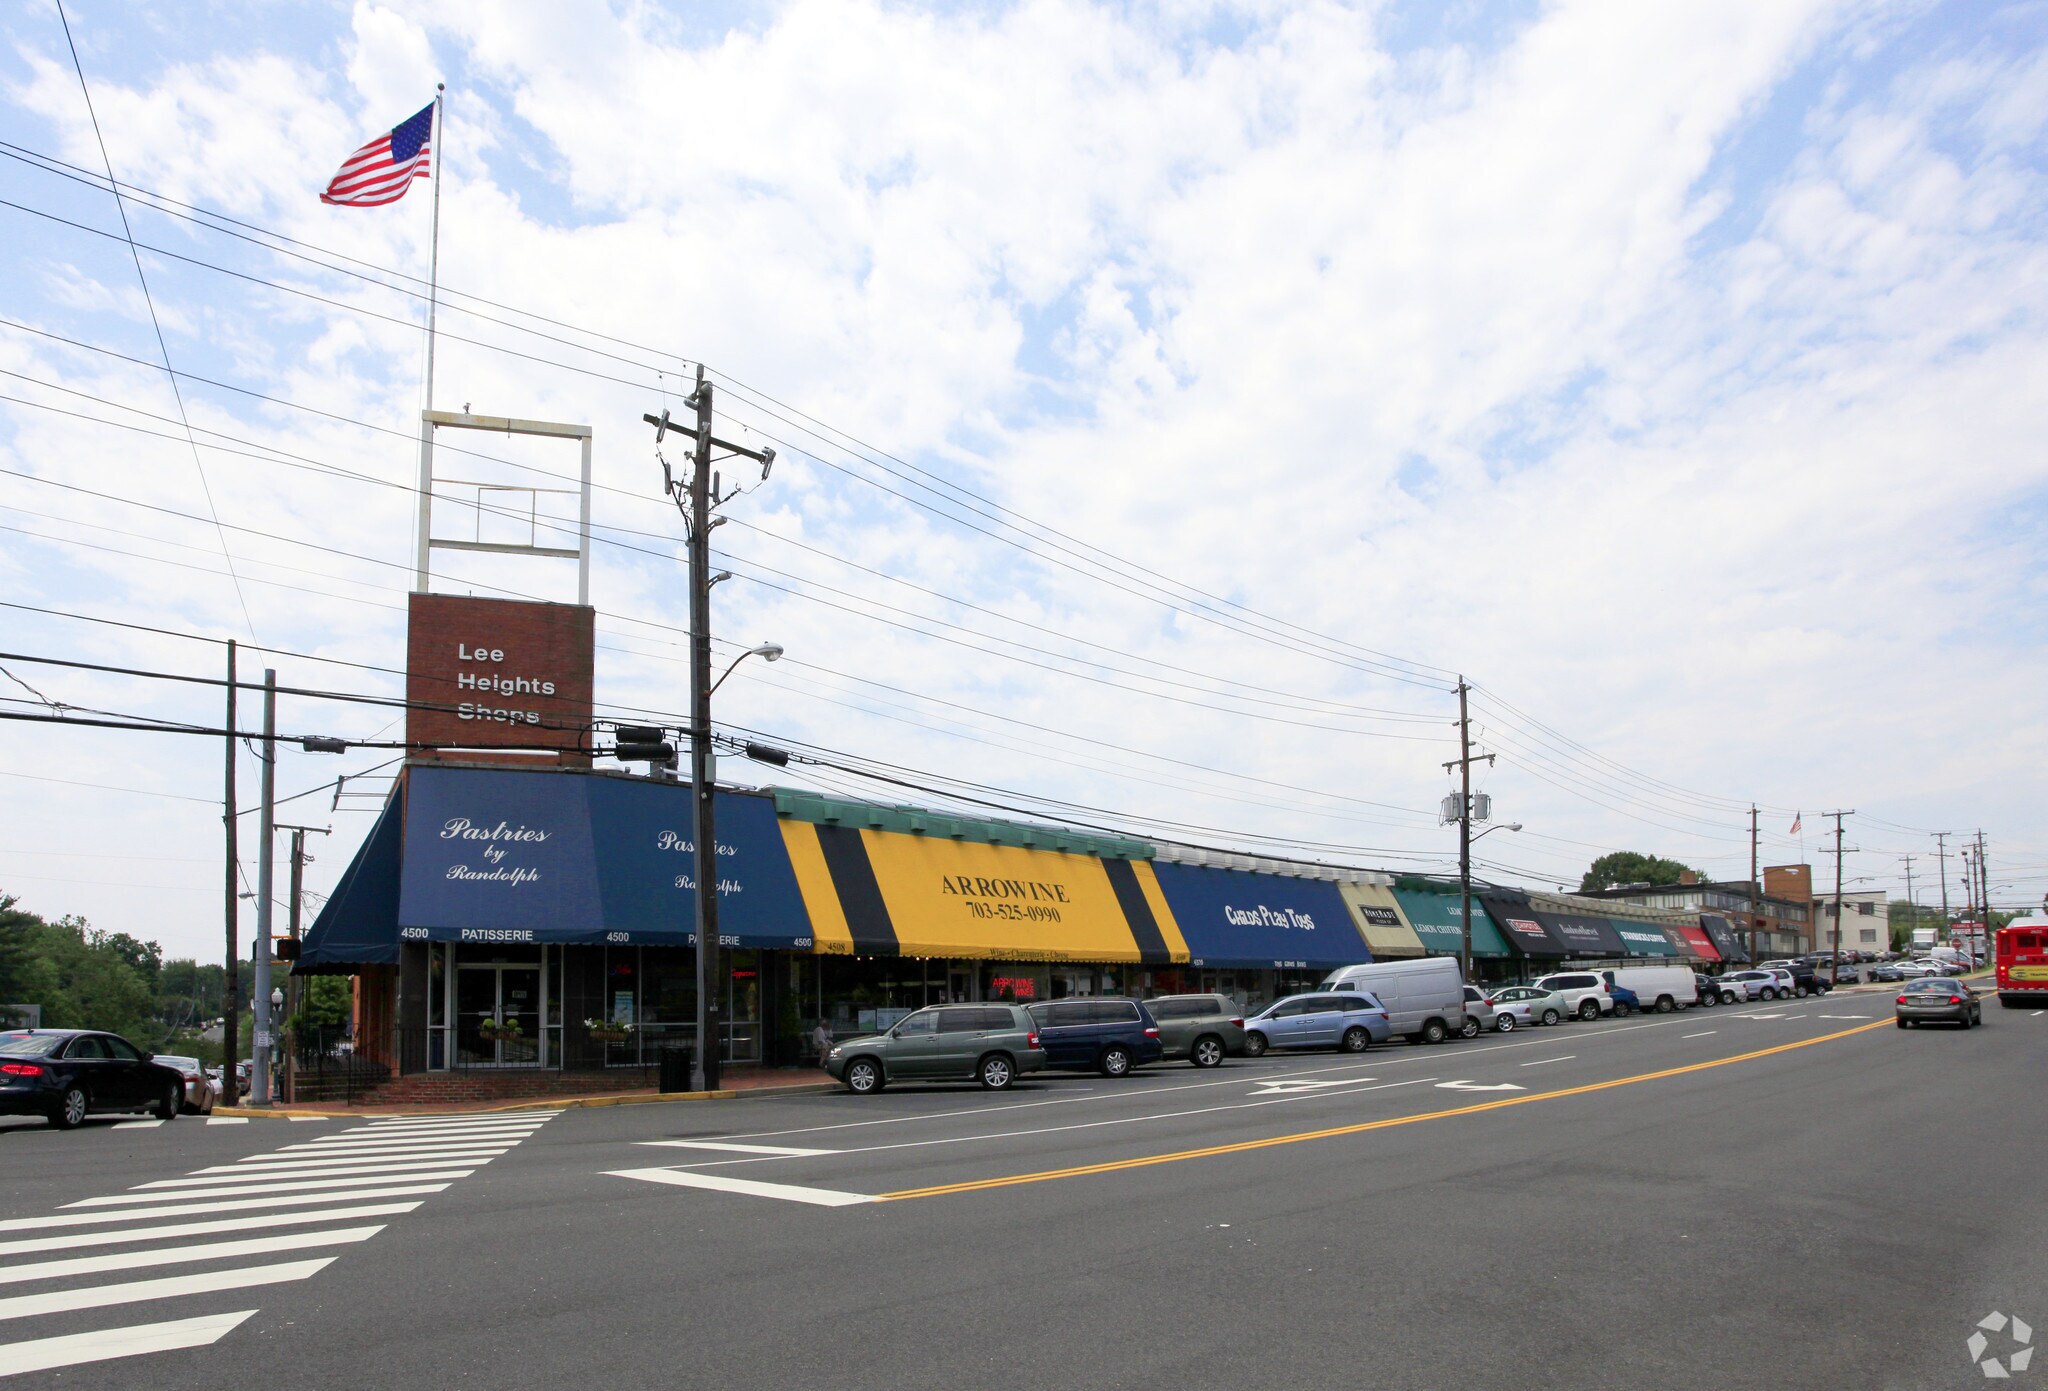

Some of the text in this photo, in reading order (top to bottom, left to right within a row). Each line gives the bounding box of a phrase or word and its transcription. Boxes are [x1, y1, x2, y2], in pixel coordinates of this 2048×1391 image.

[458, 643, 504, 662] Lee
[458, 672, 555, 697] Heights
[457, 702, 540, 726] Shops
[440, 817, 552, 842] Pastries
[484, 844, 509, 864] by
[657, 830, 738, 856] Pasies
[446, 864, 542, 886] Randolph
[674, 874, 743, 896] Raolph
[942, 874, 1070, 903] ARROWINE
[965, 901, 1061, 923] 703-525-0990
[401, 927, 534, 941] 4500 PATISSERIE
[606, 932, 630, 942] 4500
[793, 937, 812, 947] 4500
